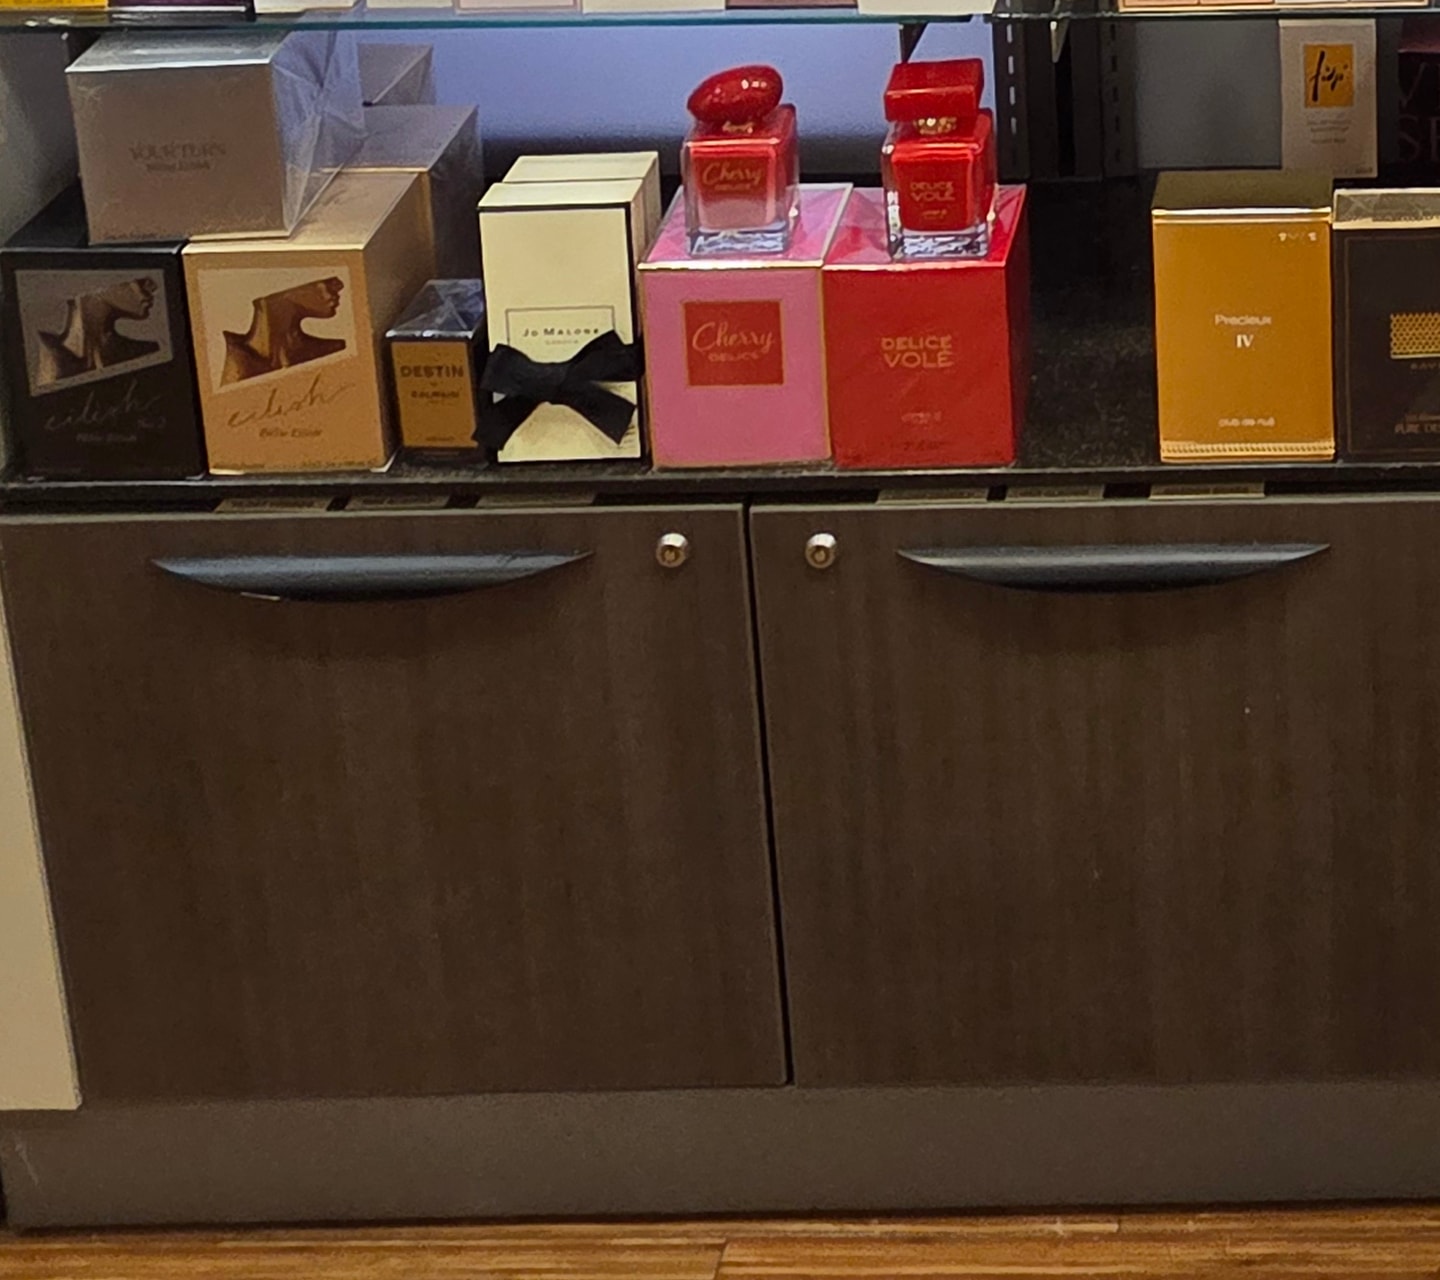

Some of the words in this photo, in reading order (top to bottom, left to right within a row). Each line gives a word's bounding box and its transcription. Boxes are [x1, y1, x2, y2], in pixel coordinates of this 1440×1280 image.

[701, 161, 764, 186] Cherry
[910, 180, 954, 192] DELICE
[692, 321, 774, 352] Cherry
[881, 334, 953, 351] DELICE
[1235, 334, 1254, 349] IV
[708, 352, 760, 363] DELICE
[400, 365, 464, 378] DESTIN
